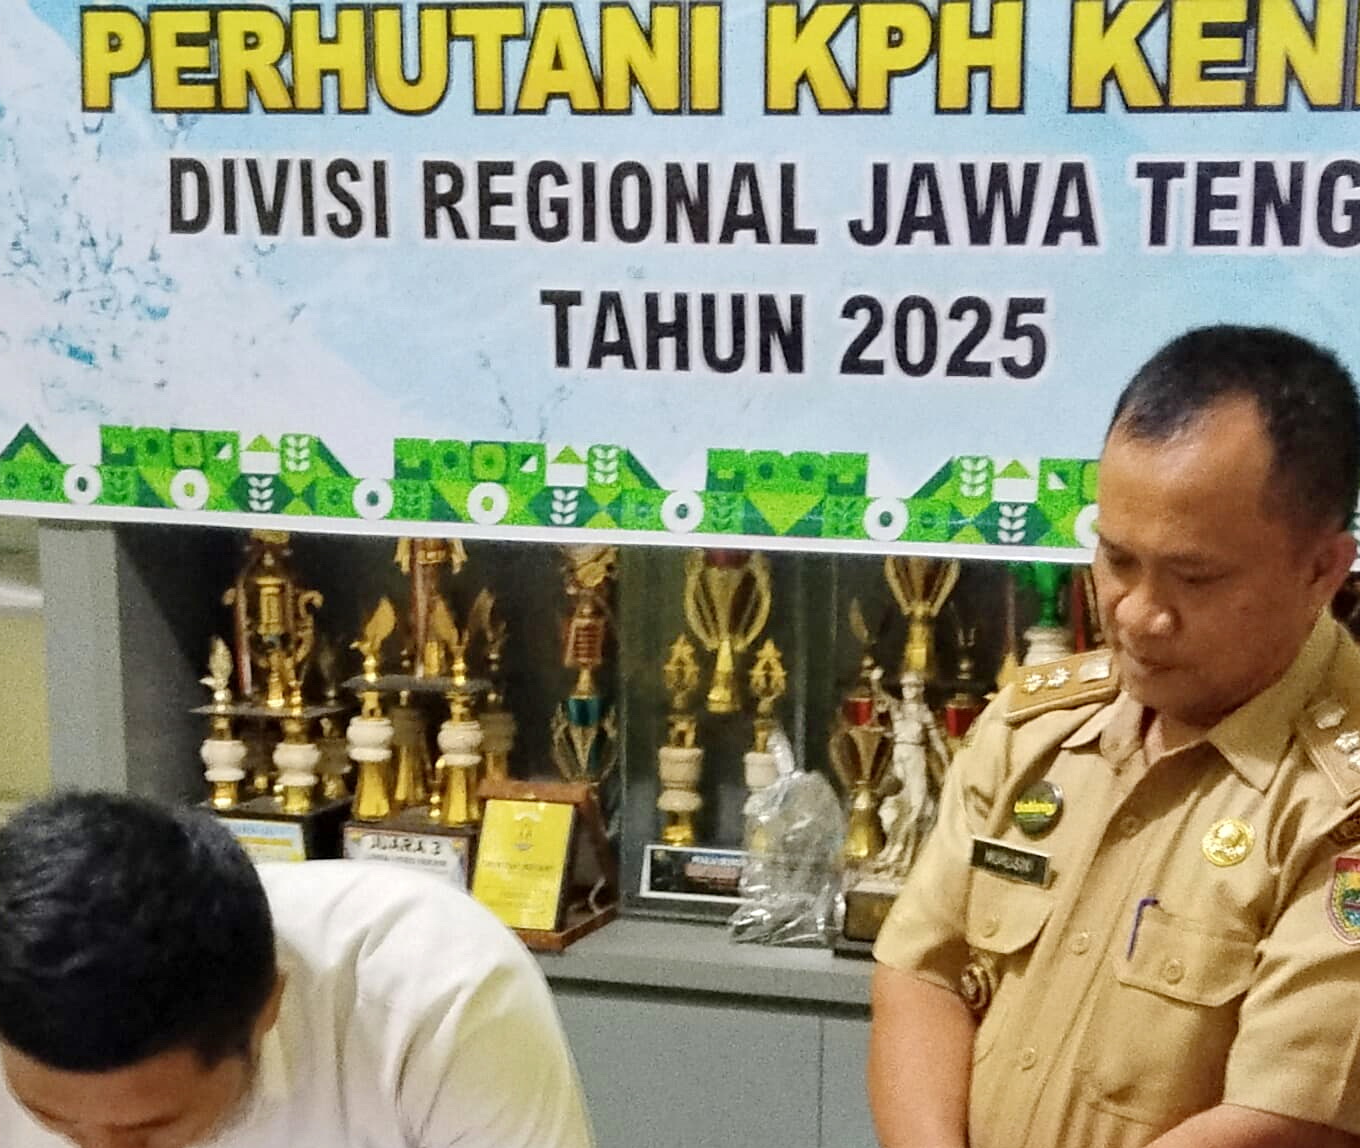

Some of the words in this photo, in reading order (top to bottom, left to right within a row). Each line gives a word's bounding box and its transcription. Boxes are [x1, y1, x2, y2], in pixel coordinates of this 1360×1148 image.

[80, 3, 724, 116] PERHUTANI
[764, 0, 1025, 115] KPH
[169, 157, 390, 239] DIVISI
[422, 160, 818, 246] REGIONAL
[848, 161, 1100, 248] JAWA
[540, 290, 806, 375] TAHUN
[839, 295, 1048, 380] 2025
